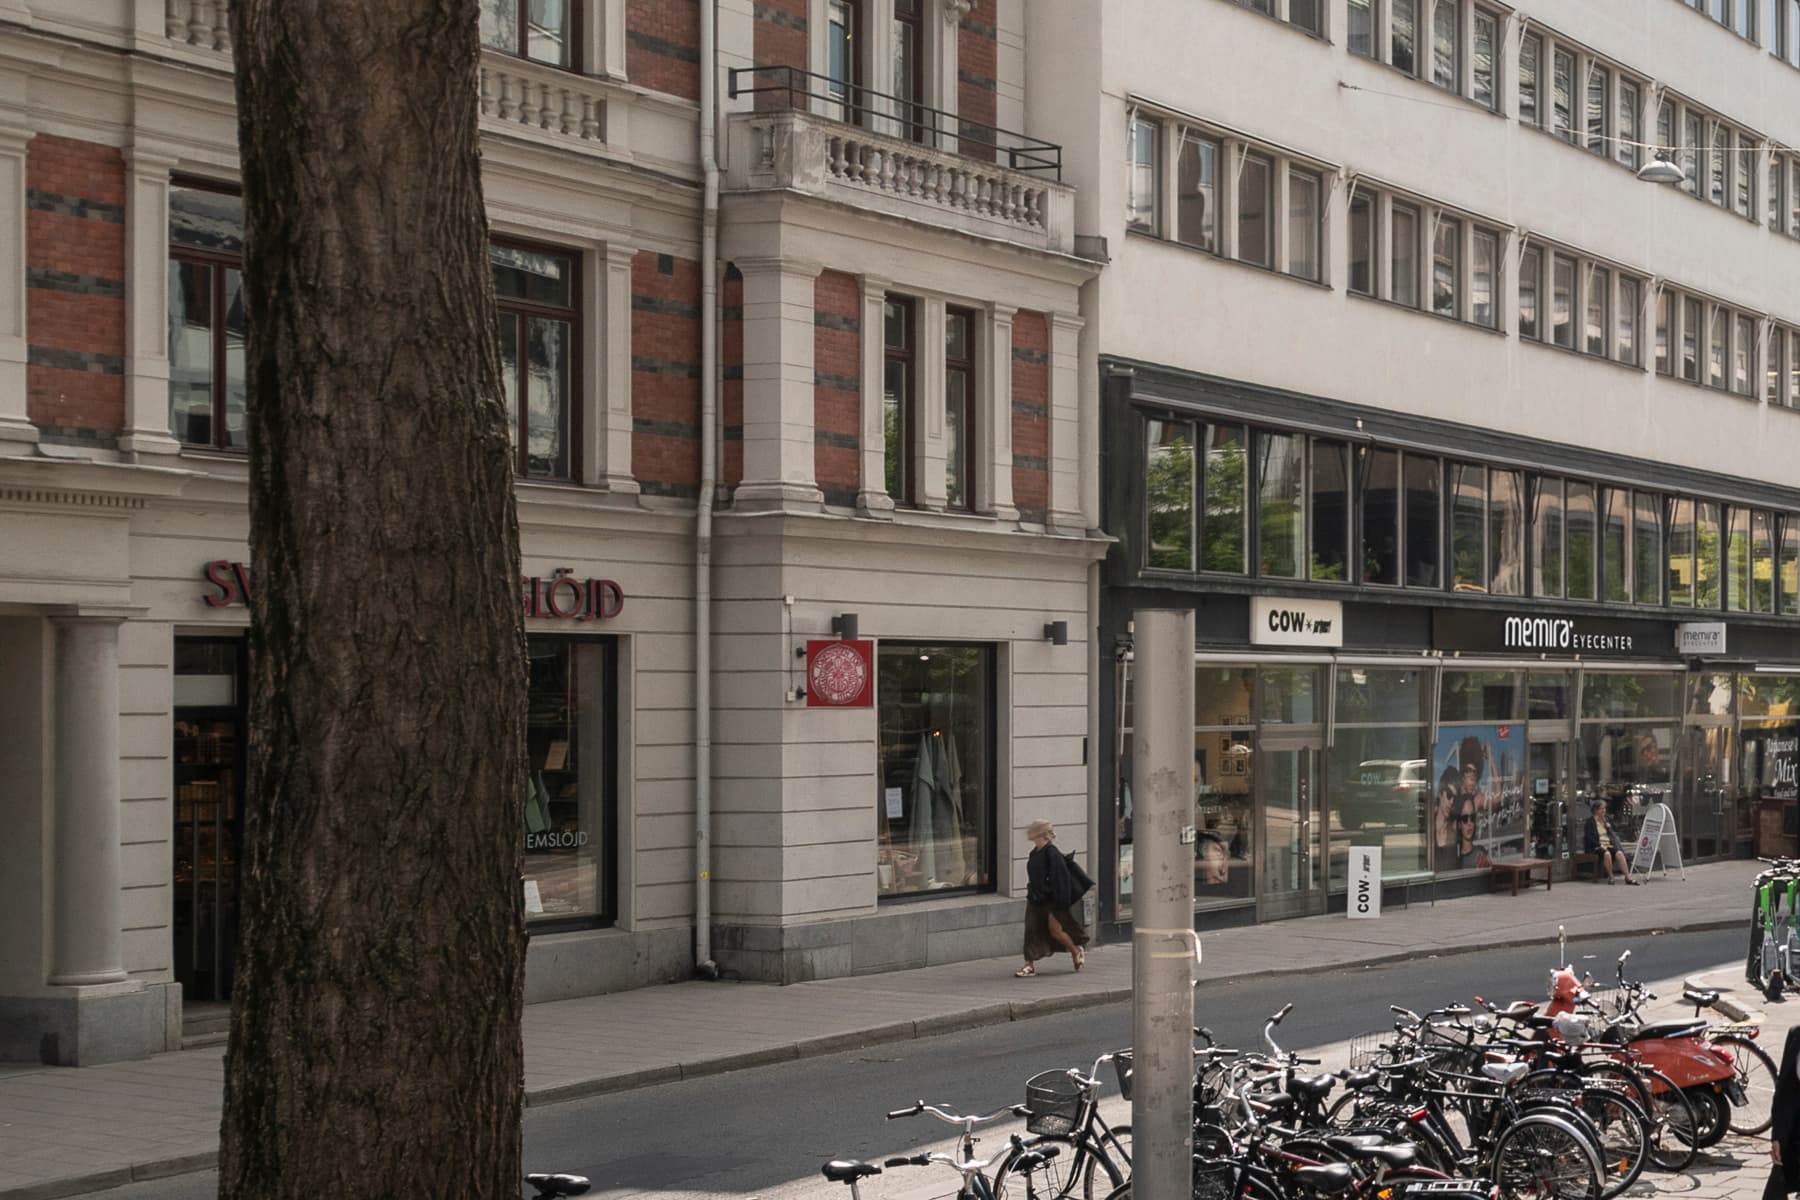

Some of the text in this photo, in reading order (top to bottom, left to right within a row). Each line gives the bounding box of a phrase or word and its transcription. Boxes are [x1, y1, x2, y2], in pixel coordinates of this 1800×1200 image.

[1268, 609, 1306, 633] COW
[1504, 616, 1633, 650] memira EYECENTER
[1682, 631, 1720, 641] memira
[1357, 879, 1370, 914] COW
